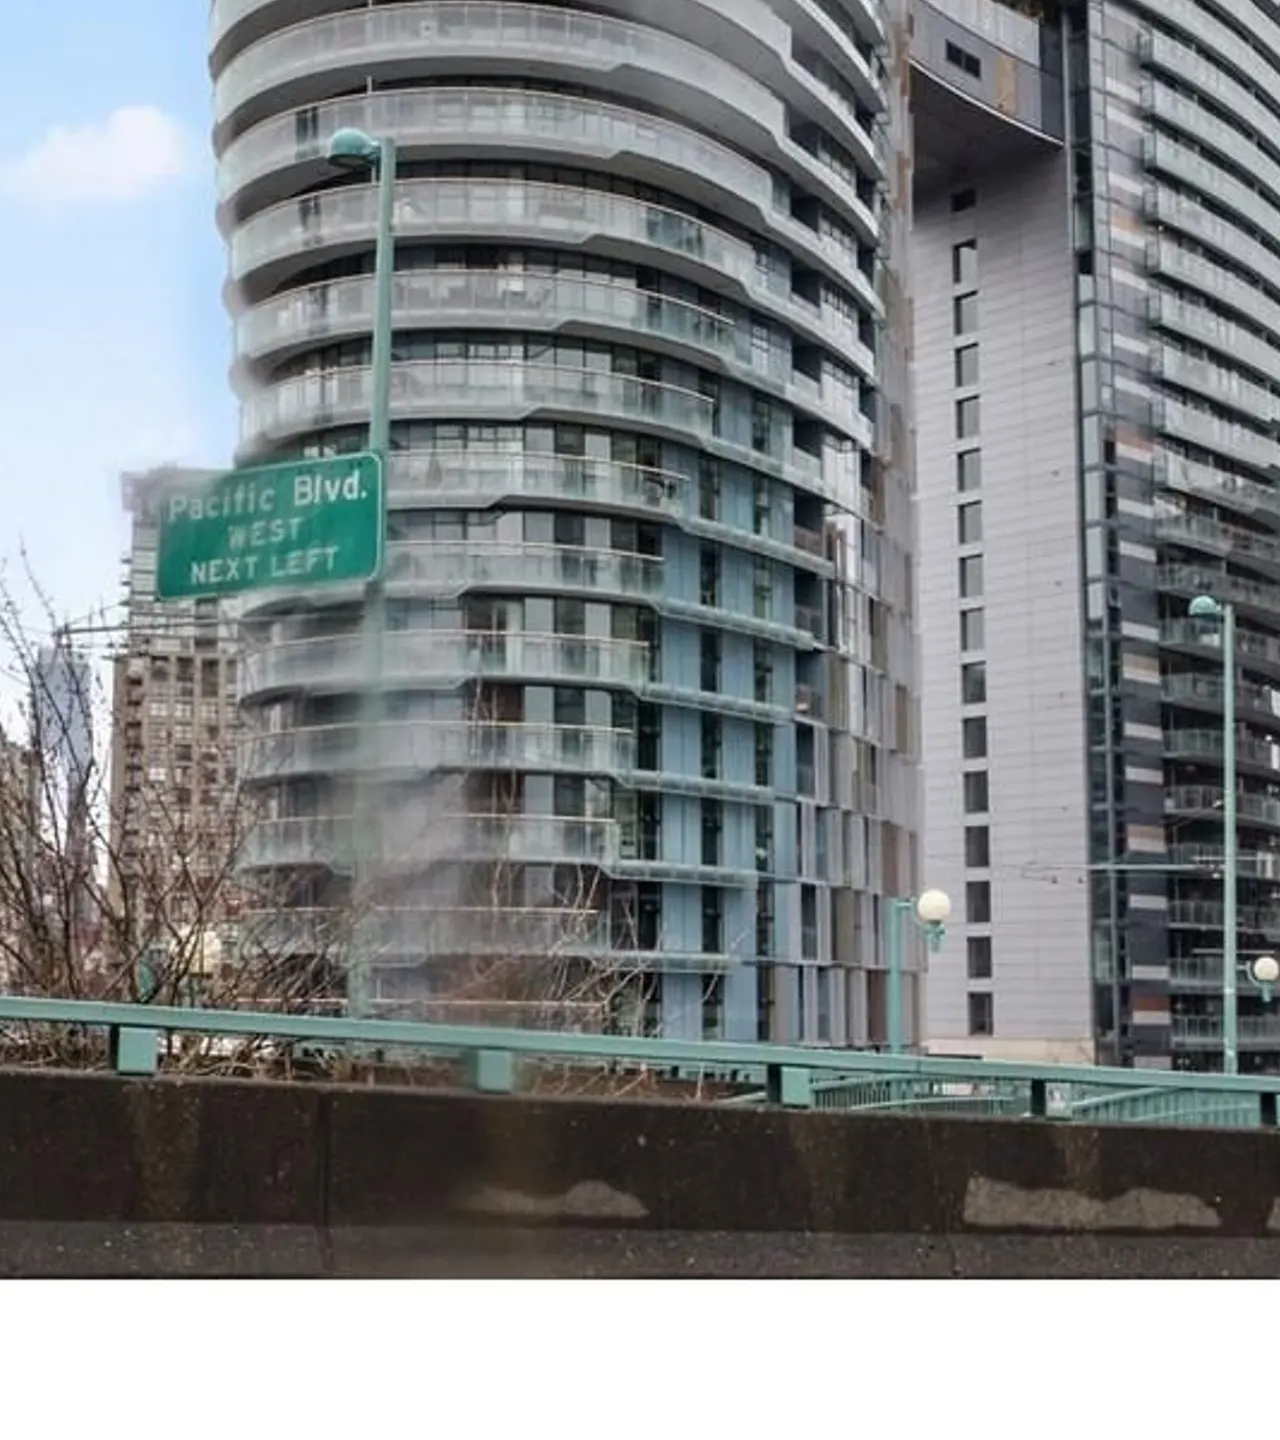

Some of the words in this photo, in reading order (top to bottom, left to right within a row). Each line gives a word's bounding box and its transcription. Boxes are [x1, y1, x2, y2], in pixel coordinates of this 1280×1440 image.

[169, 482, 276, 521] Pacific
[293, 468, 368, 507] Blvd.
[227, 516, 304, 550] WEST
[190, 555, 259, 586] NEXT
[271, 545, 340, 578] LEFT
